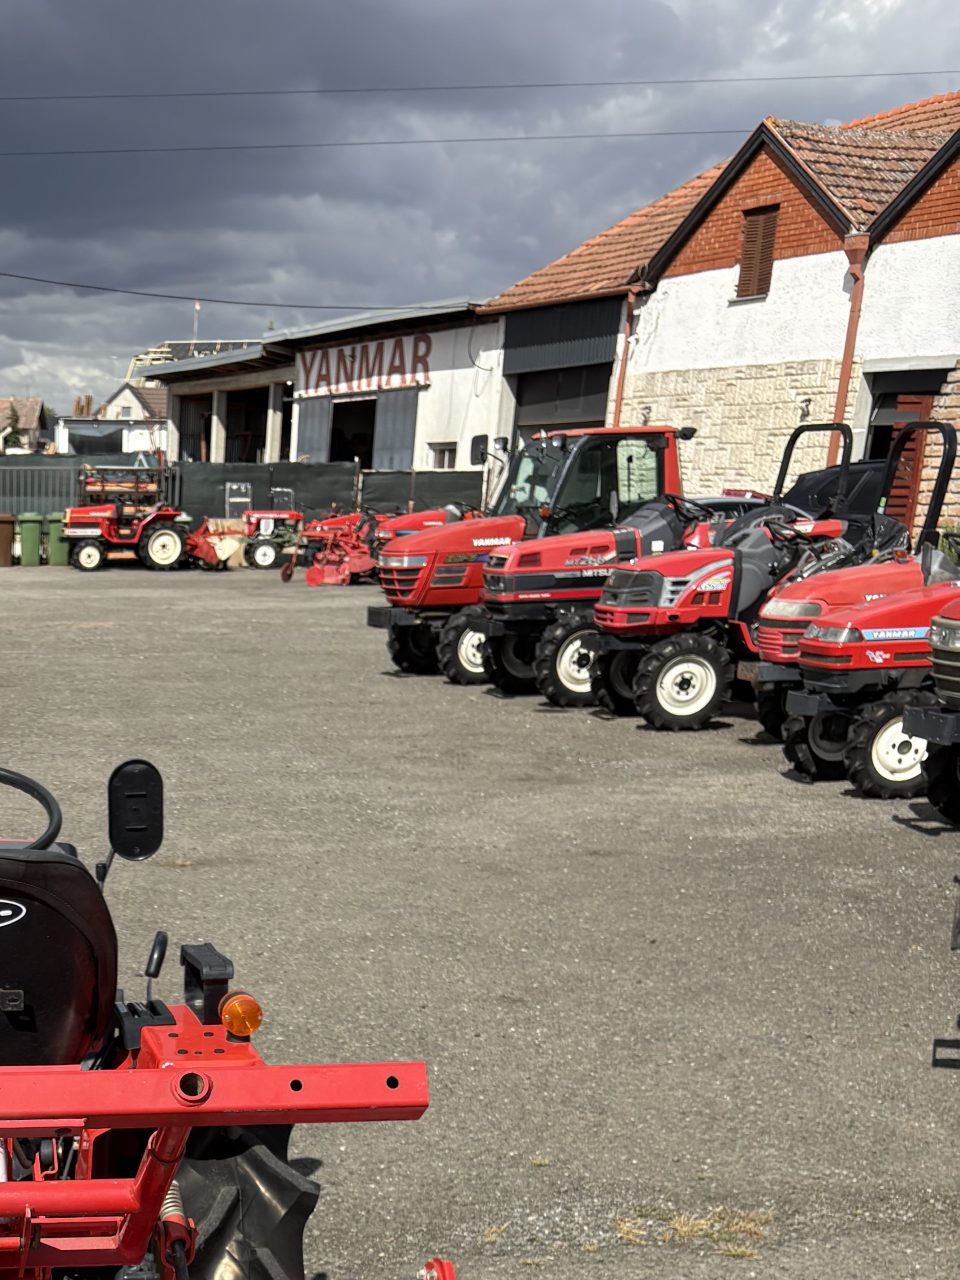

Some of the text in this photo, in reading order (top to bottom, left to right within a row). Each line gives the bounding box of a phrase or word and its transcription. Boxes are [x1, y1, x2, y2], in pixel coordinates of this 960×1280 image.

[300, 333, 432, 395] YANMAR
[472, 537, 512, 547] YANMAR
[872, 630, 916, 639] YANMAR
